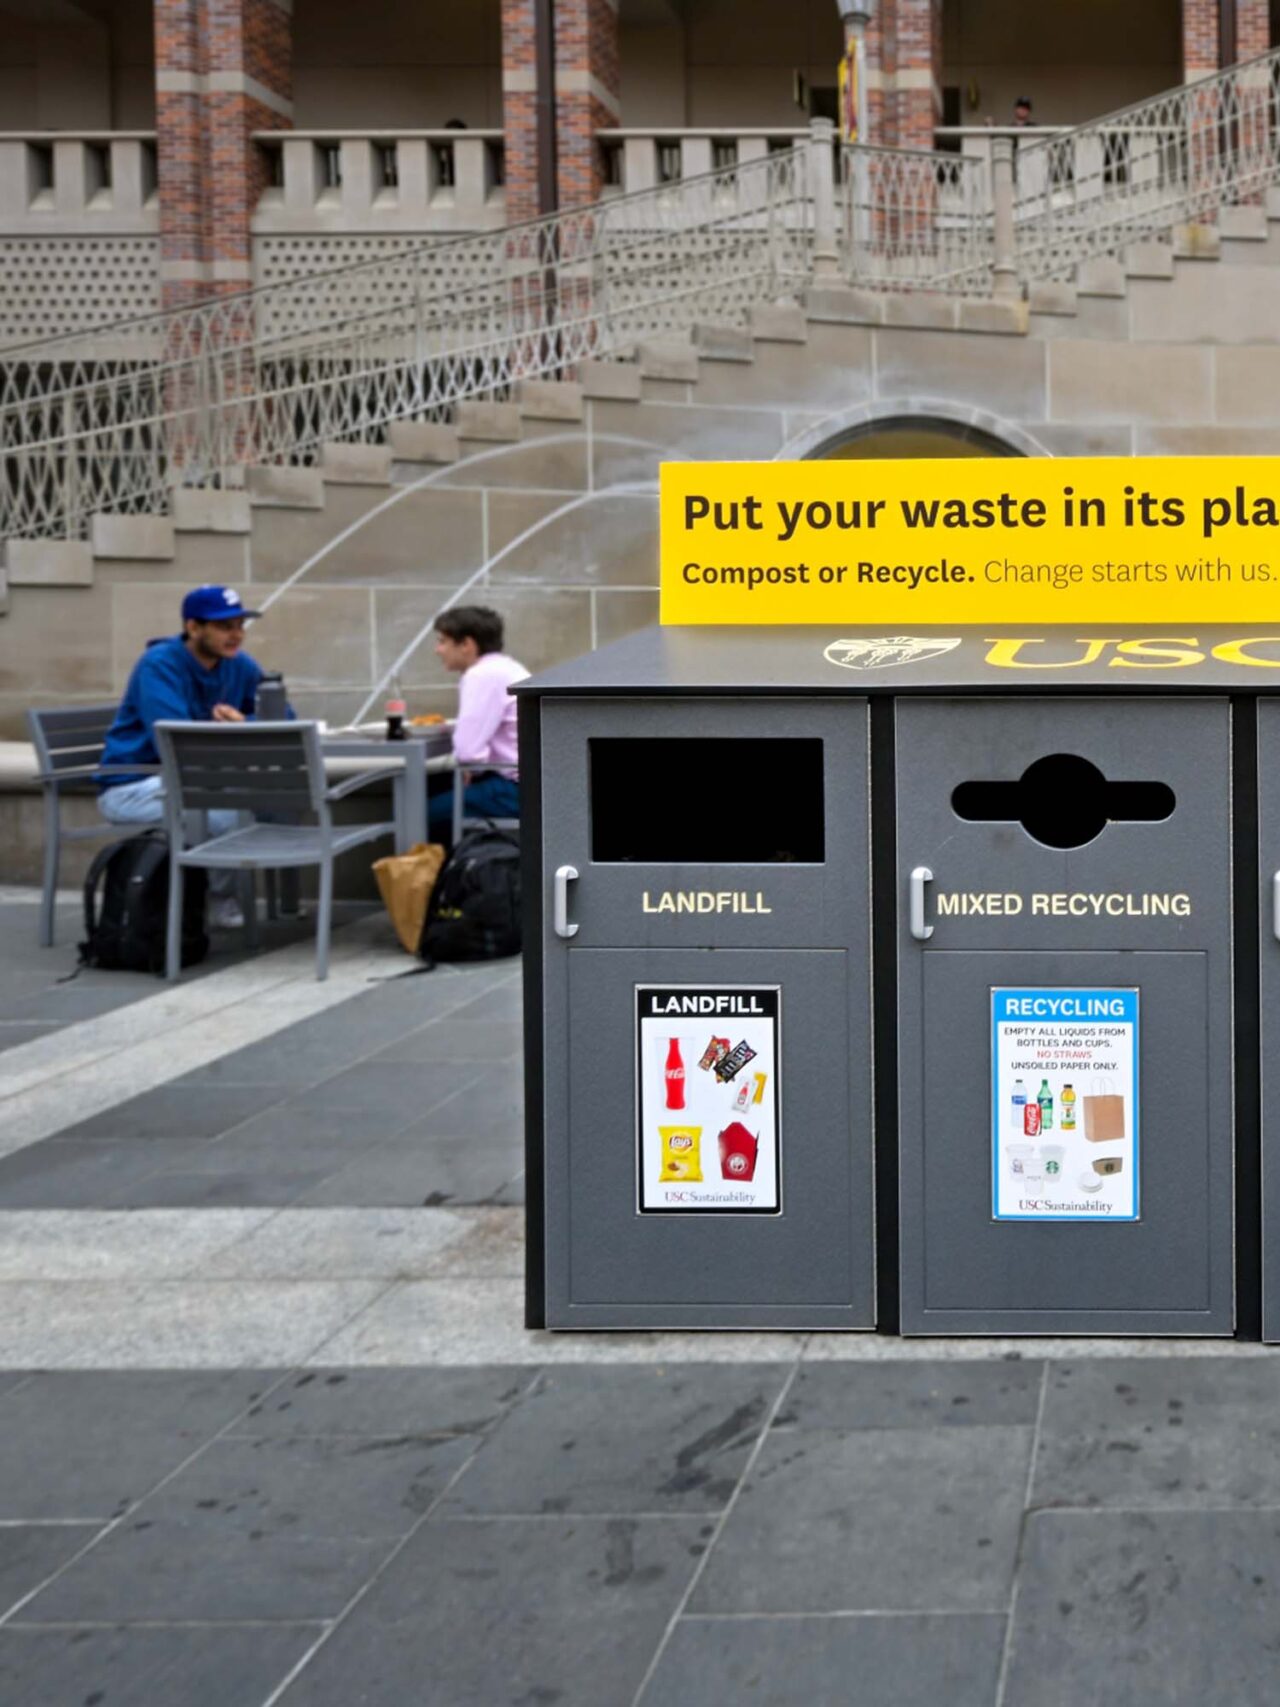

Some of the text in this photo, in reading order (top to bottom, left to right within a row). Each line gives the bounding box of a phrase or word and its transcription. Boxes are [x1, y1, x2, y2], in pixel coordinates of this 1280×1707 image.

[685, 496, 763, 530] Put
[777, 501, 885, 541] your
[900, 493, 1046, 528] waste
[1064, 487, 1105, 526] in
[1124, 486, 1185, 526] its
[683, 558, 1277, 590] Compost or Recycle. Change starts with us.
[643, 892, 771, 913] LANDFILL
[938, 894, 1190, 915] MIXED RECYCLING
[652, 996, 763, 1013] LANDFILL
[1006, 998, 1124, 1016] RECYCLING
[1004, 1027, 1035, 1035] EMPTY
[1059, 1028, 1095, 1037] LIQUIDS
[1099, 1028, 1125, 1036] FROM
[1017, 1039, 1059, 1047] BOTTLES
[1054, 1050, 1092, 1058] STRAWS
[1061, 1062, 1090, 1070] PAPER
[1093, 1062, 1118, 1070] ONLY.
[665, 1191, 756, 1205] USC Sustainability
[1019, 1199, 1113, 1214] USC Sustainability
